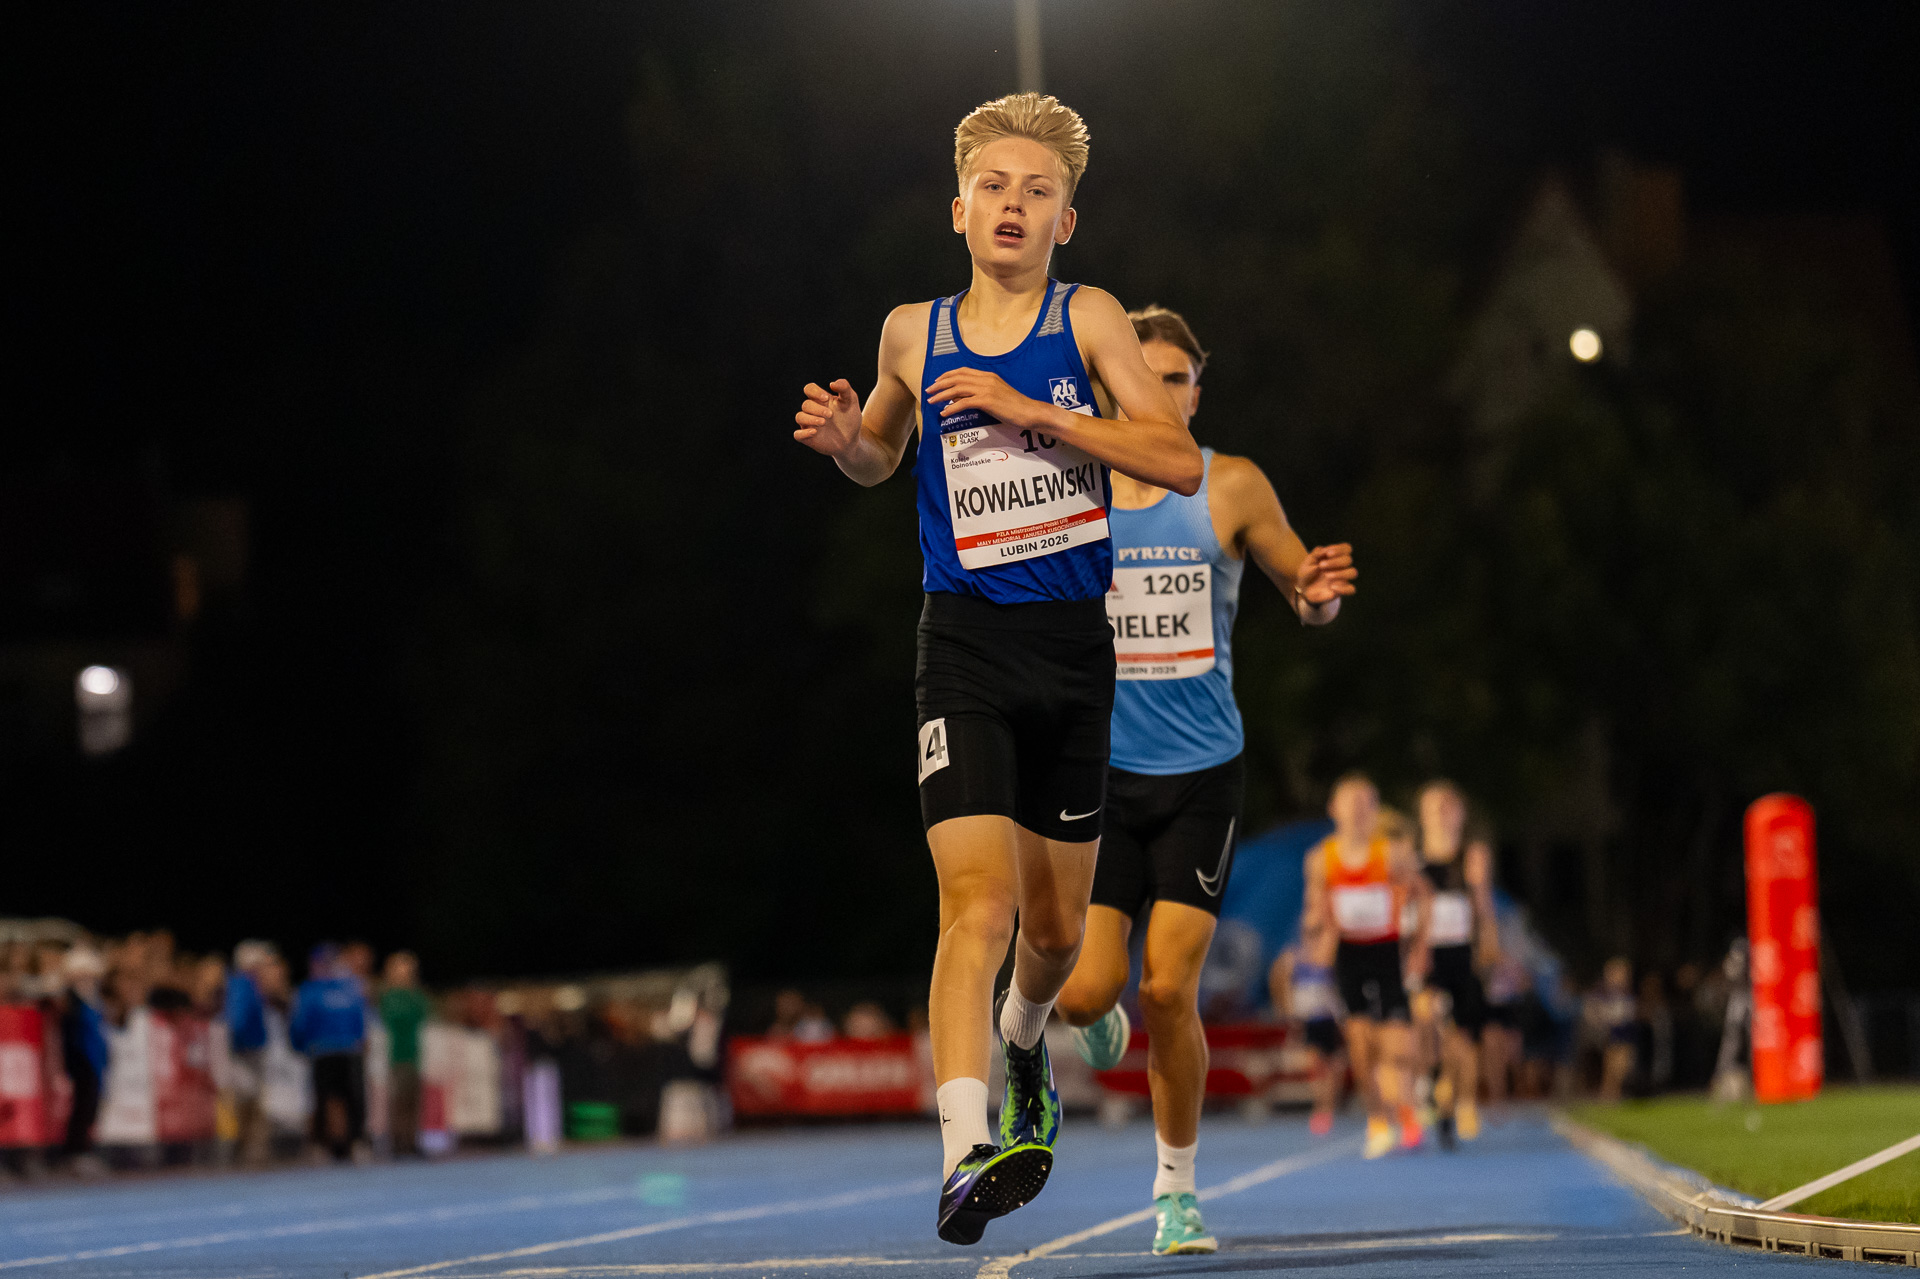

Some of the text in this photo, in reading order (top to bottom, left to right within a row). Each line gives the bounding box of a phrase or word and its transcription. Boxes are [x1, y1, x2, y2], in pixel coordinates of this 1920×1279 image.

[959, 430, 980, 440] DOLNY
[954, 462, 1096, 520] KOWALEWSKI
[996, 530, 1011, 538] PZLA
[1011, 525, 1043, 535] Mistrzostwa
[1043, 519, 1059, 528] Polski
[1022, 530, 1047, 539] JANUSZA
[1000, 534, 1069, 557] LUBIN 2026
[1118, 546, 1202, 561] PYRZYCE
[1143, 572, 1205, 595] 1205
[1107, 613, 1190, 638] IELEK
